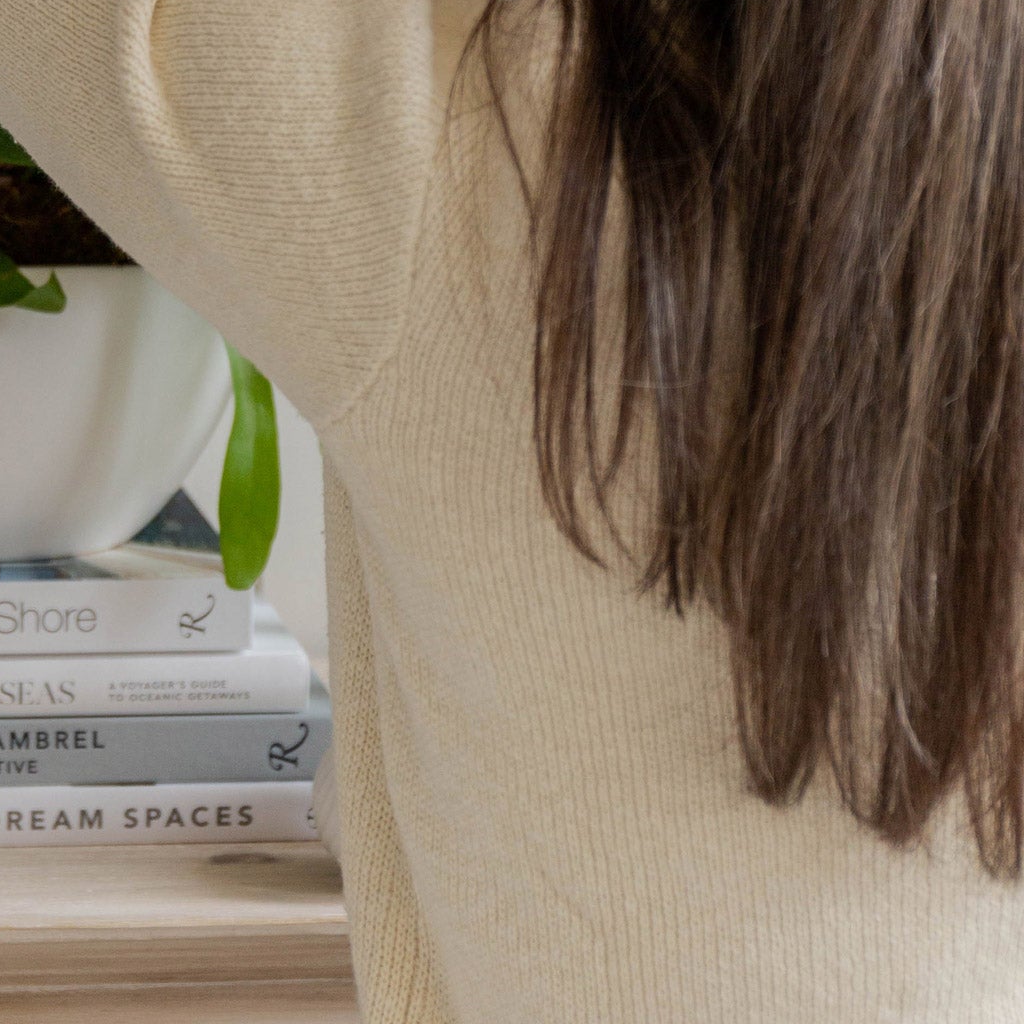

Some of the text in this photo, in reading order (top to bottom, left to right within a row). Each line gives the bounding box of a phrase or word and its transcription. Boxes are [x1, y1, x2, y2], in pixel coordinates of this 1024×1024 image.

[120, 680, 186, 690] VOYAGER'S
[189, 679, 227, 689] GUIDE
[108, 690, 252, 702] TO OCEANIC GETAWAYS
[123, 805, 254, 829] SPACES
